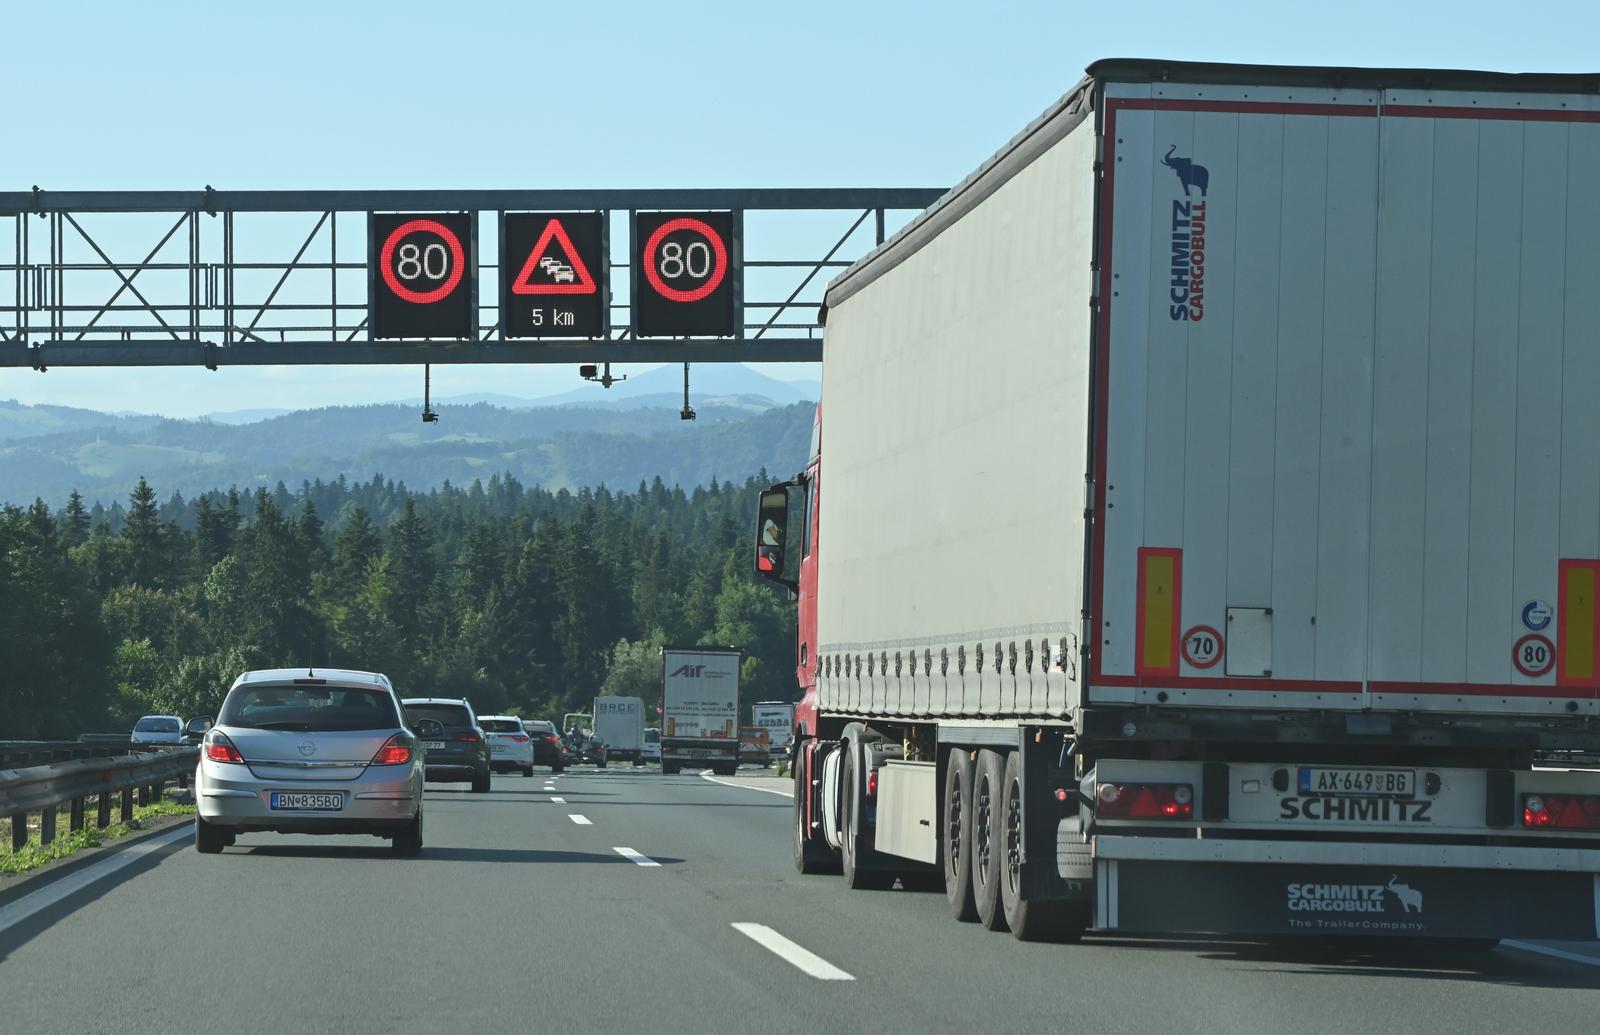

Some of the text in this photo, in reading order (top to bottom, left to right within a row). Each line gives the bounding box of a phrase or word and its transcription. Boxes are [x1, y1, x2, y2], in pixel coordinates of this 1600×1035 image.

[397, 243, 447, 280] 80
[660, 242, 709, 278] 80
[1170, 199, 1190, 320] SCHMITZ
[1189, 200, 1206, 321] CARGOBULL
[532, 308, 574, 326] 5 km
[1193, 637, 1213, 655] 70
[1524, 645, 1546, 663] 80
[1386, 773, 1406, 792] BG
[1280, 797, 1432, 822] SCHMITZ
[1287, 882, 1385, 900] SCHMITZ
[1287, 899, 1385, 912] CARGOBULL
[1288, 919, 1312, 928] The
